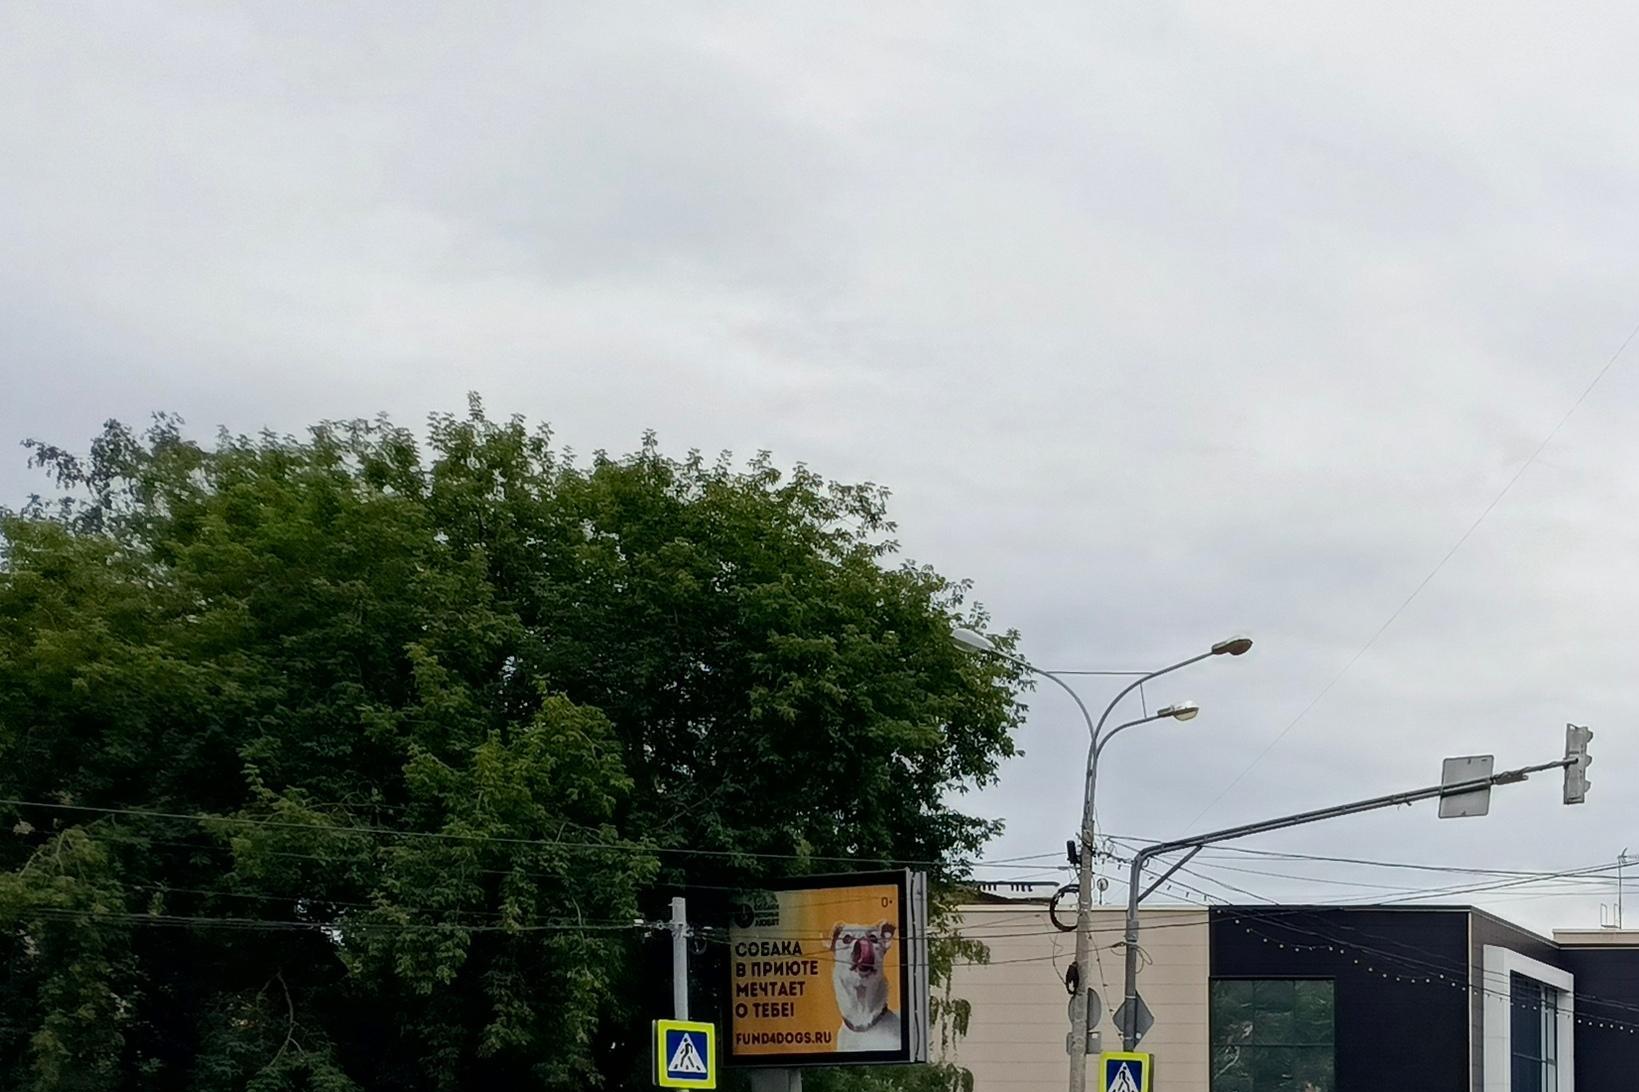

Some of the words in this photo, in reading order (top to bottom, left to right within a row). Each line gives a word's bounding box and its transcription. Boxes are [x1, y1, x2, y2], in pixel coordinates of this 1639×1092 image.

[735, 941, 802, 957] СОБАКА
[736, 962, 746, 977] В
[751, 960, 818, 977] ПРИЮТЕ
[736, 981, 806, 998] МЕЧТАЕТ
[735, 1004, 748, 1018] О
[753, 1002, 794, 1018] ТЕБЕ!
[736, 1031, 832, 1045] FUND4DOGS.RU
